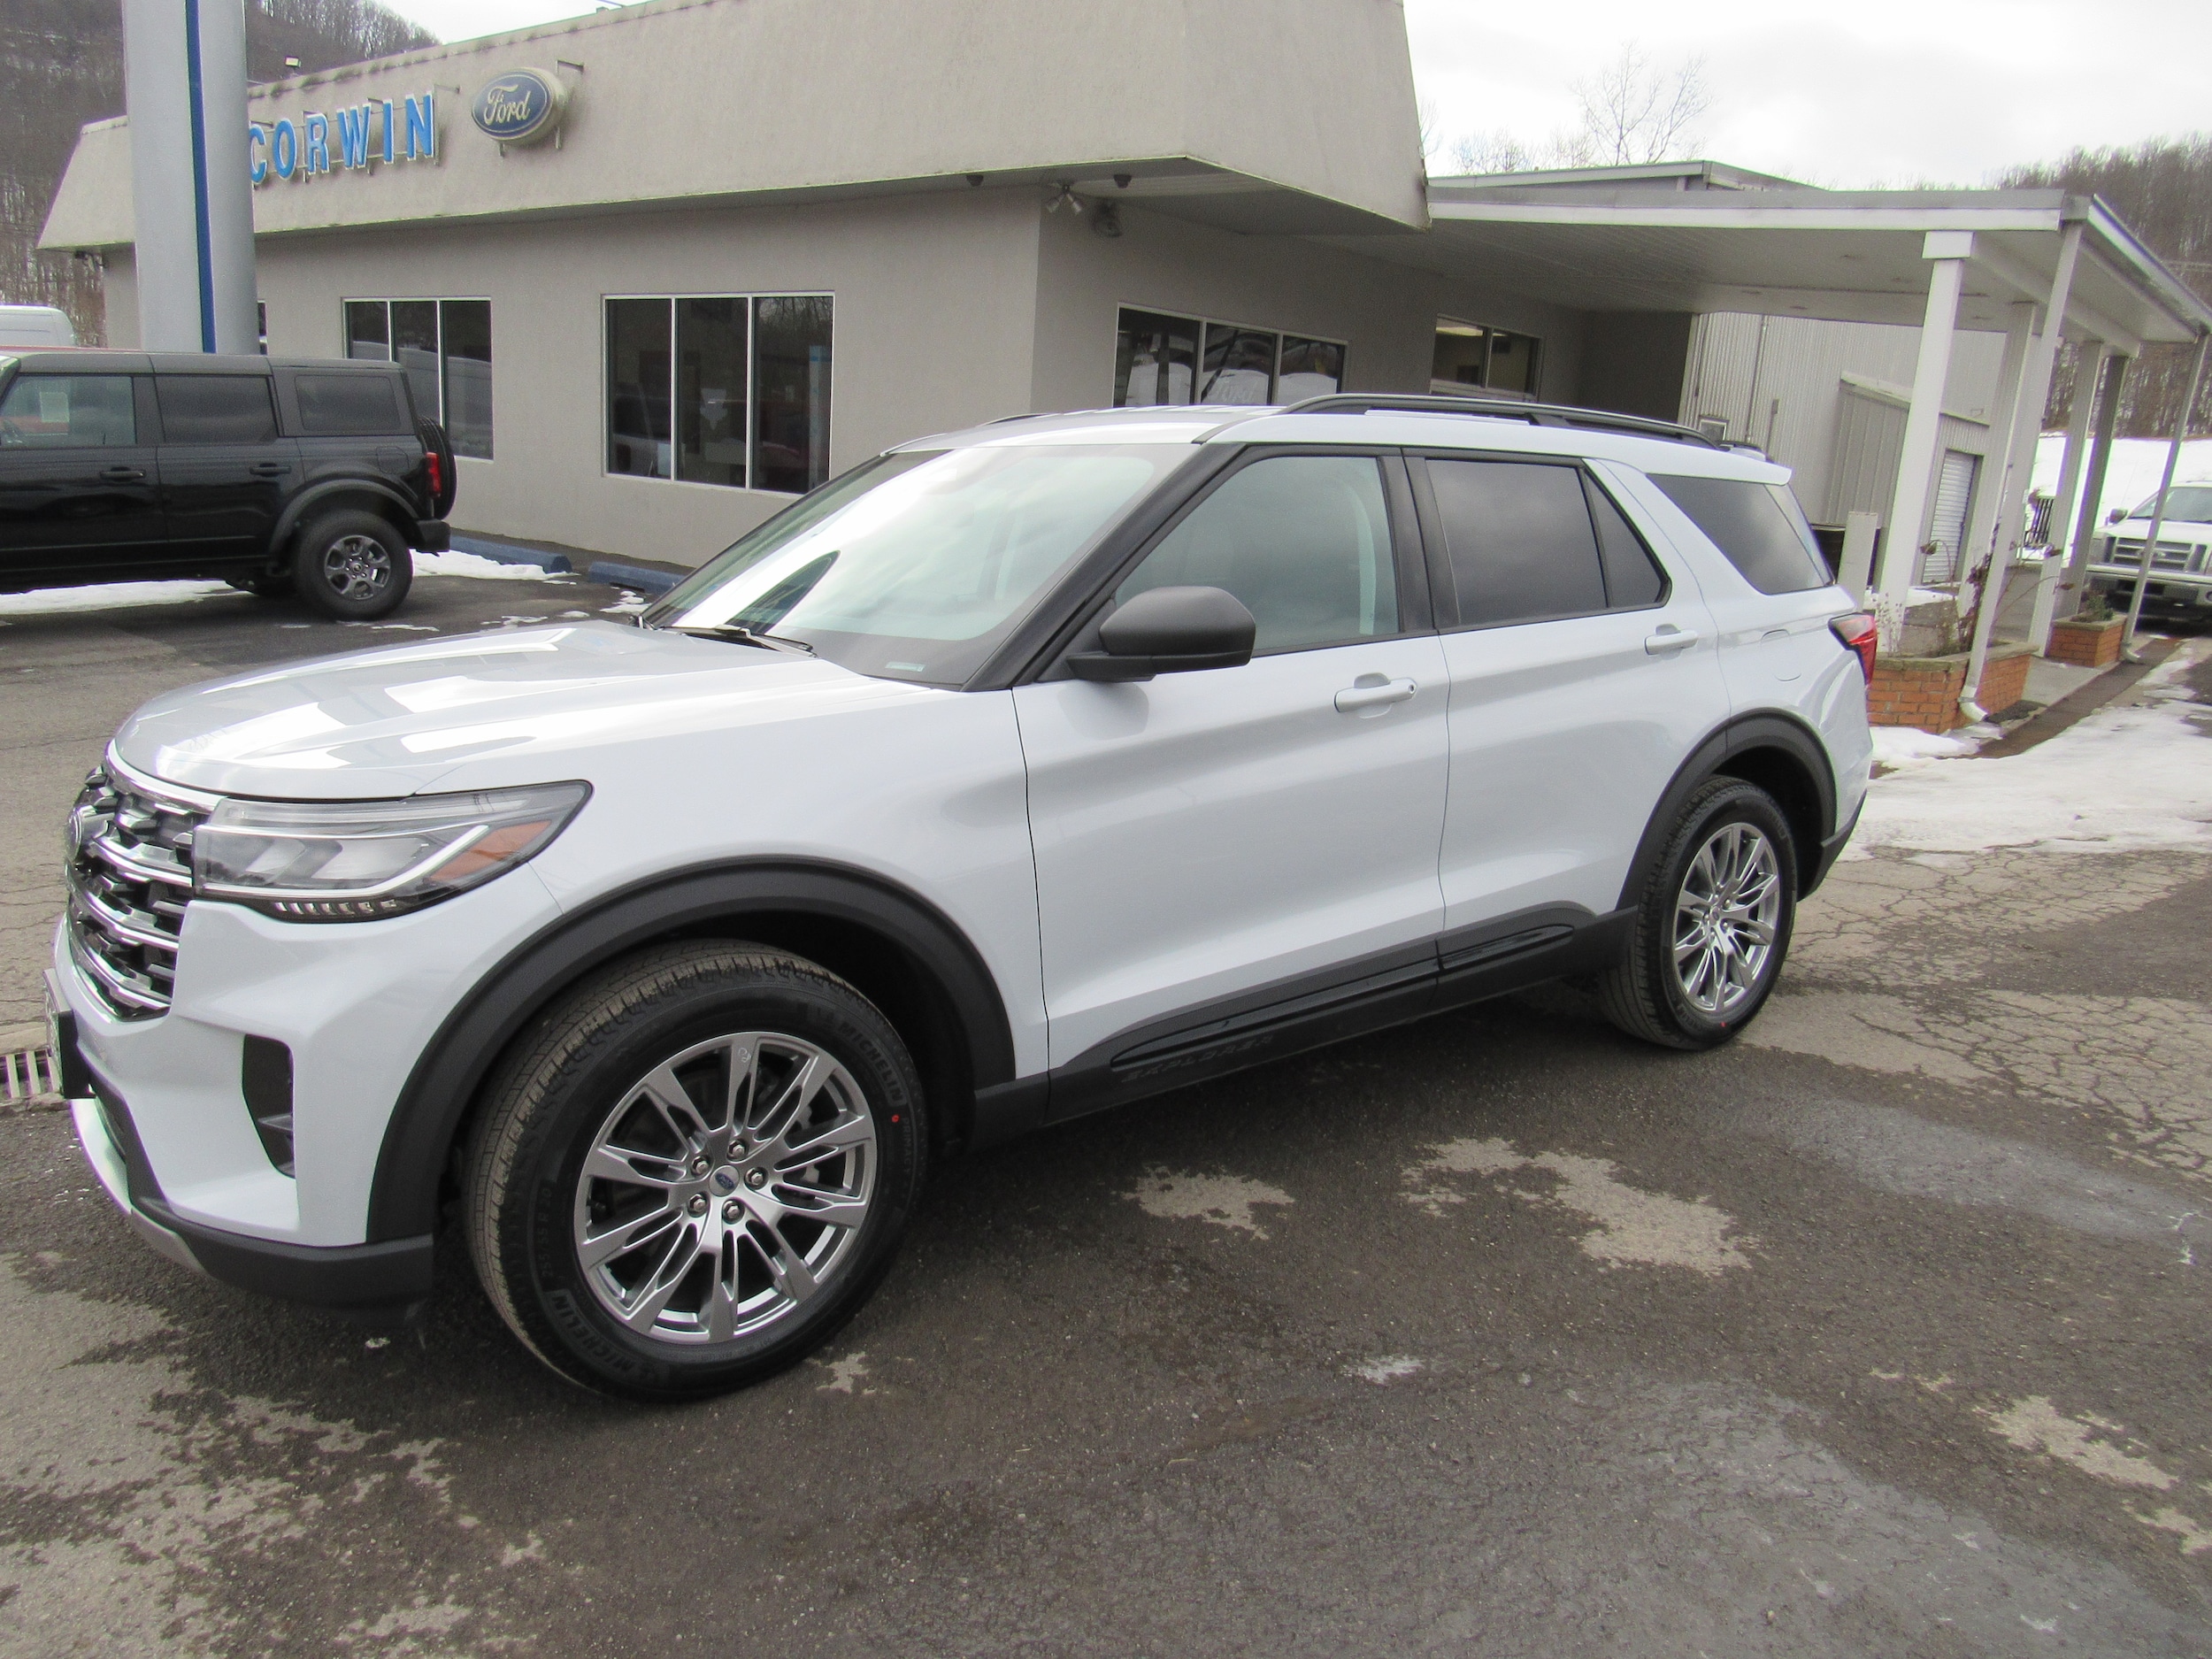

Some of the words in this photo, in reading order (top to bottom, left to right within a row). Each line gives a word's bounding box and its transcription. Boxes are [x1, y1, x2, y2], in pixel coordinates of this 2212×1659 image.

[249, 90, 434, 184] CORWIN
[484, 84, 531, 126] Ford
[839, 1022, 903, 1102] MICHELIN
[552, 1295, 634, 1371] MICHELIN
